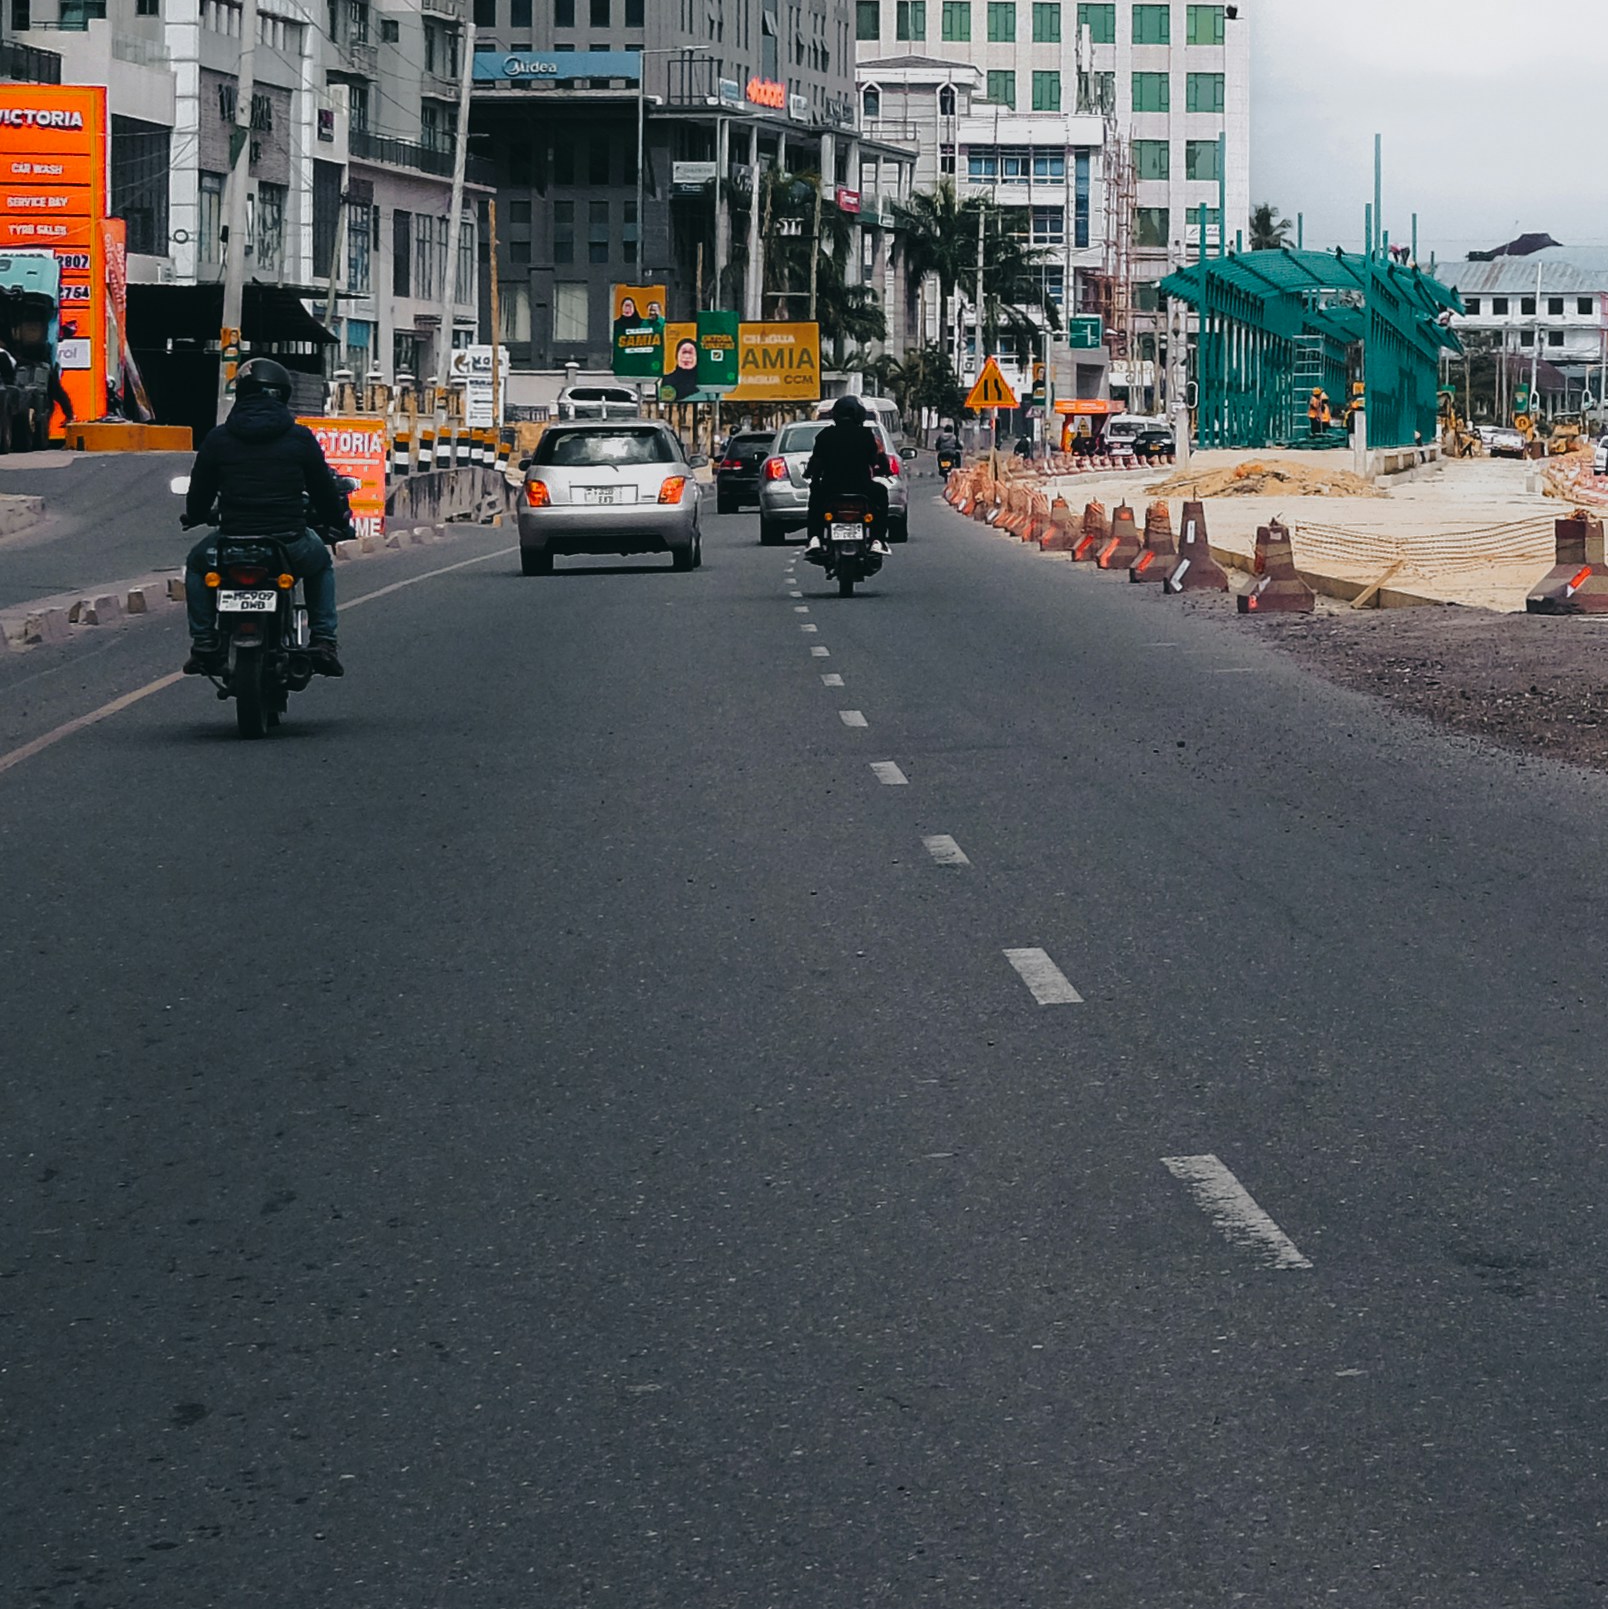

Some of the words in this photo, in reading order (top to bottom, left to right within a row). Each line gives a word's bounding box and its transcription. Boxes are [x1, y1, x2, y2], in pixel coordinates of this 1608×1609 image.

[504, 56, 558, 75] Midea
[11, 163, 31, 174] CAR
[33, 164, 63, 175] WASH
[7, 196, 46, 207] SERVICE
[618, 334, 661, 348] SAMIA
[784, 374, 814, 385] CCM
